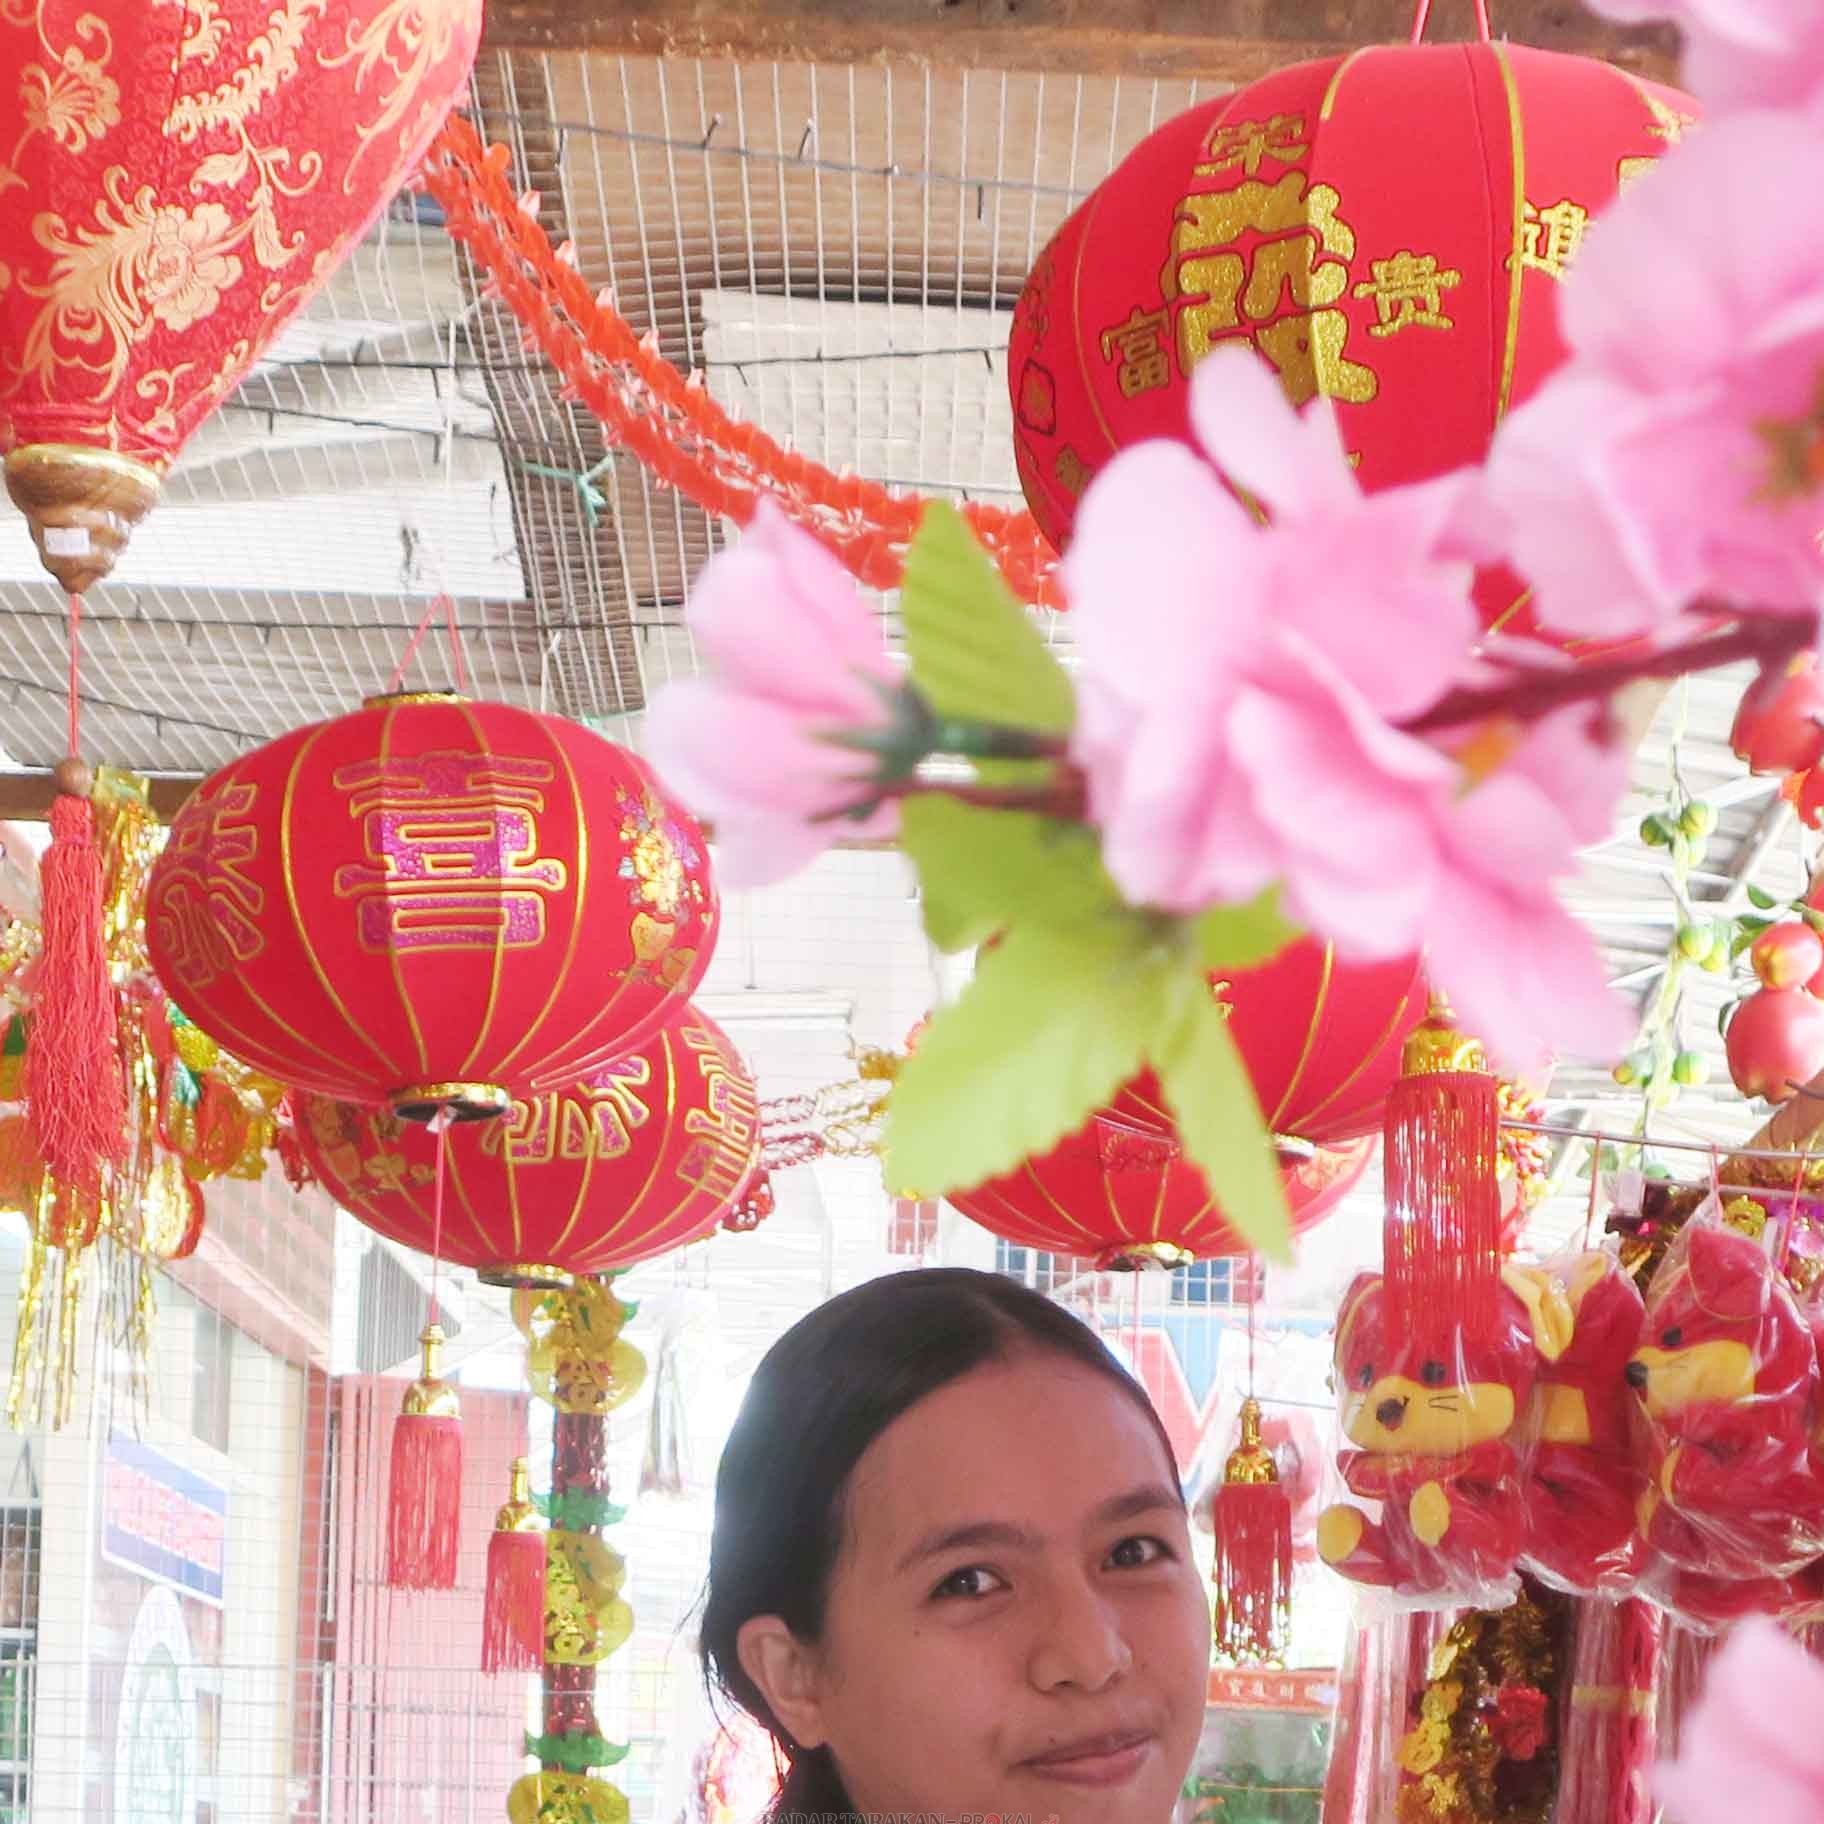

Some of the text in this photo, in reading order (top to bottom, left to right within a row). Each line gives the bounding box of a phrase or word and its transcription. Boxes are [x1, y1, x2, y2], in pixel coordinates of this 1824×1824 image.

[1353, 250, 1462, 338] 贵
[1098, 304, 1170, 400] 富
[333, 750, 567, 953] 喜
